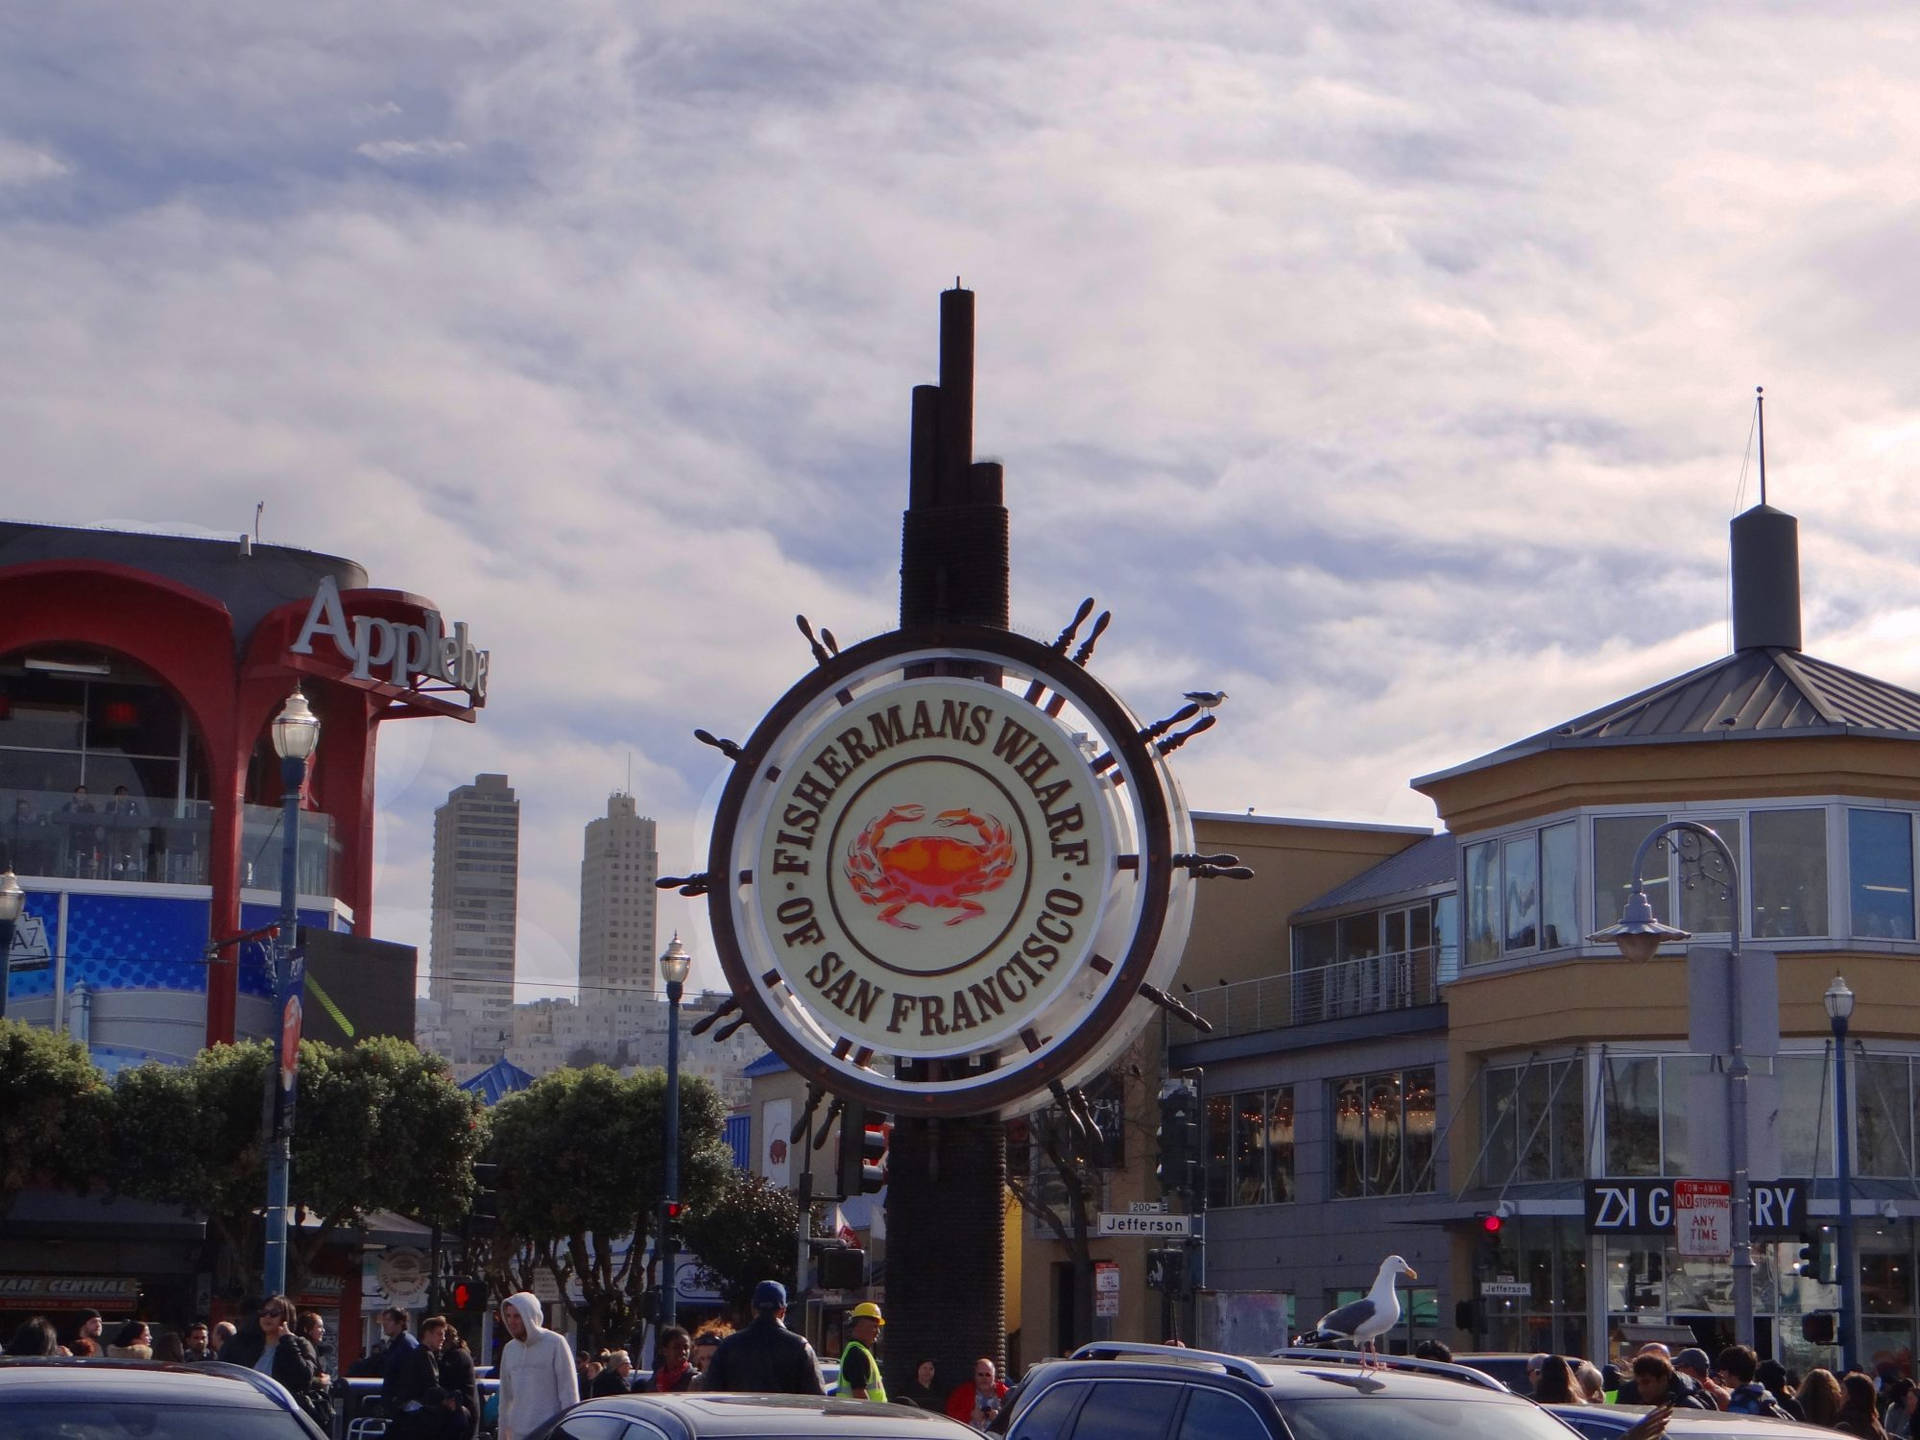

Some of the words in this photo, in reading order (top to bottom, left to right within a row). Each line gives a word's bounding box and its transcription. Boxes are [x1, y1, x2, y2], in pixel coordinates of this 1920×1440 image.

[772, 699, 993, 876] FISHERMANS
[992, 716, 1090, 867] WHARF
[777, 897, 825, 947] OF
[805, 951, 884, 1024] SAN
[886, 888, 1084, 1036] FRANCISCO
[1683, 1183, 1722, 1193] TOW-AWAY
[1677, 1193, 1693, 1208] NO
[1694, 1197, 1729, 1209] STOPPING
[1106, 1218, 1183, 1231] Jefferson
[1692, 1214, 1715, 1226] ANY
[1690, 1229, 1718, 1241] TIME
[47, 1279, 128, 1293] CENTRAL
